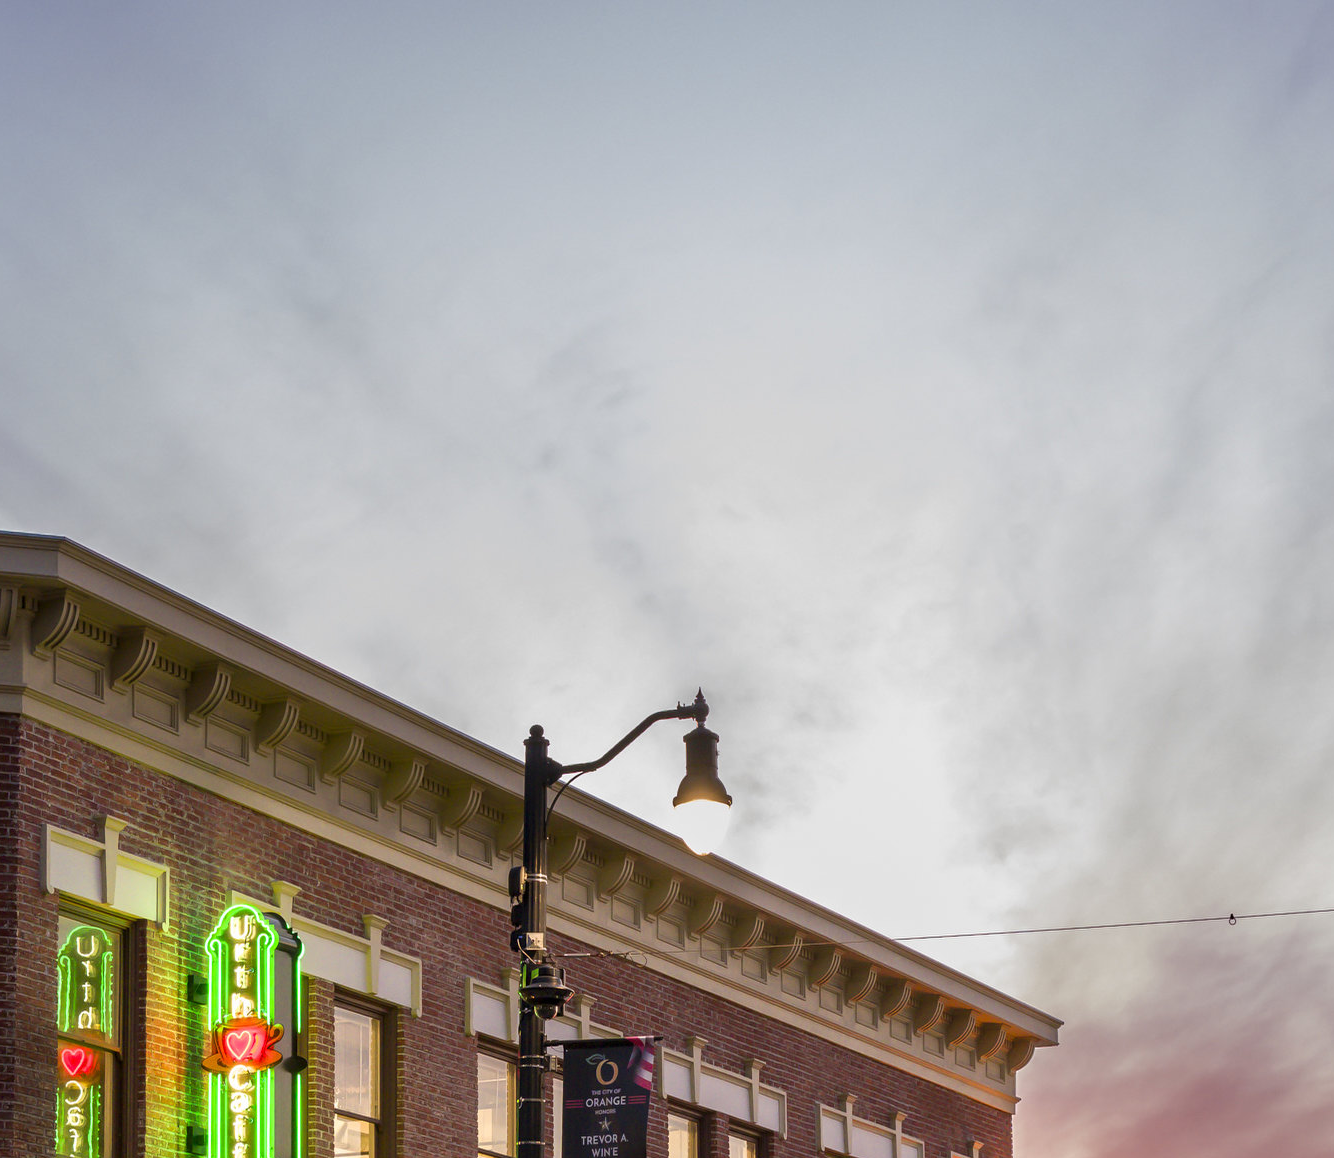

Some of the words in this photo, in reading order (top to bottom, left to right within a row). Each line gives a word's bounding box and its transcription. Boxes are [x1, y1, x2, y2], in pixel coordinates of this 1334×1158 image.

[585, 1096, 627, 1108] ORANGE
[581, 1134, 618, 1145] TREVOR
[620, 1133, 629, 1142] A.
